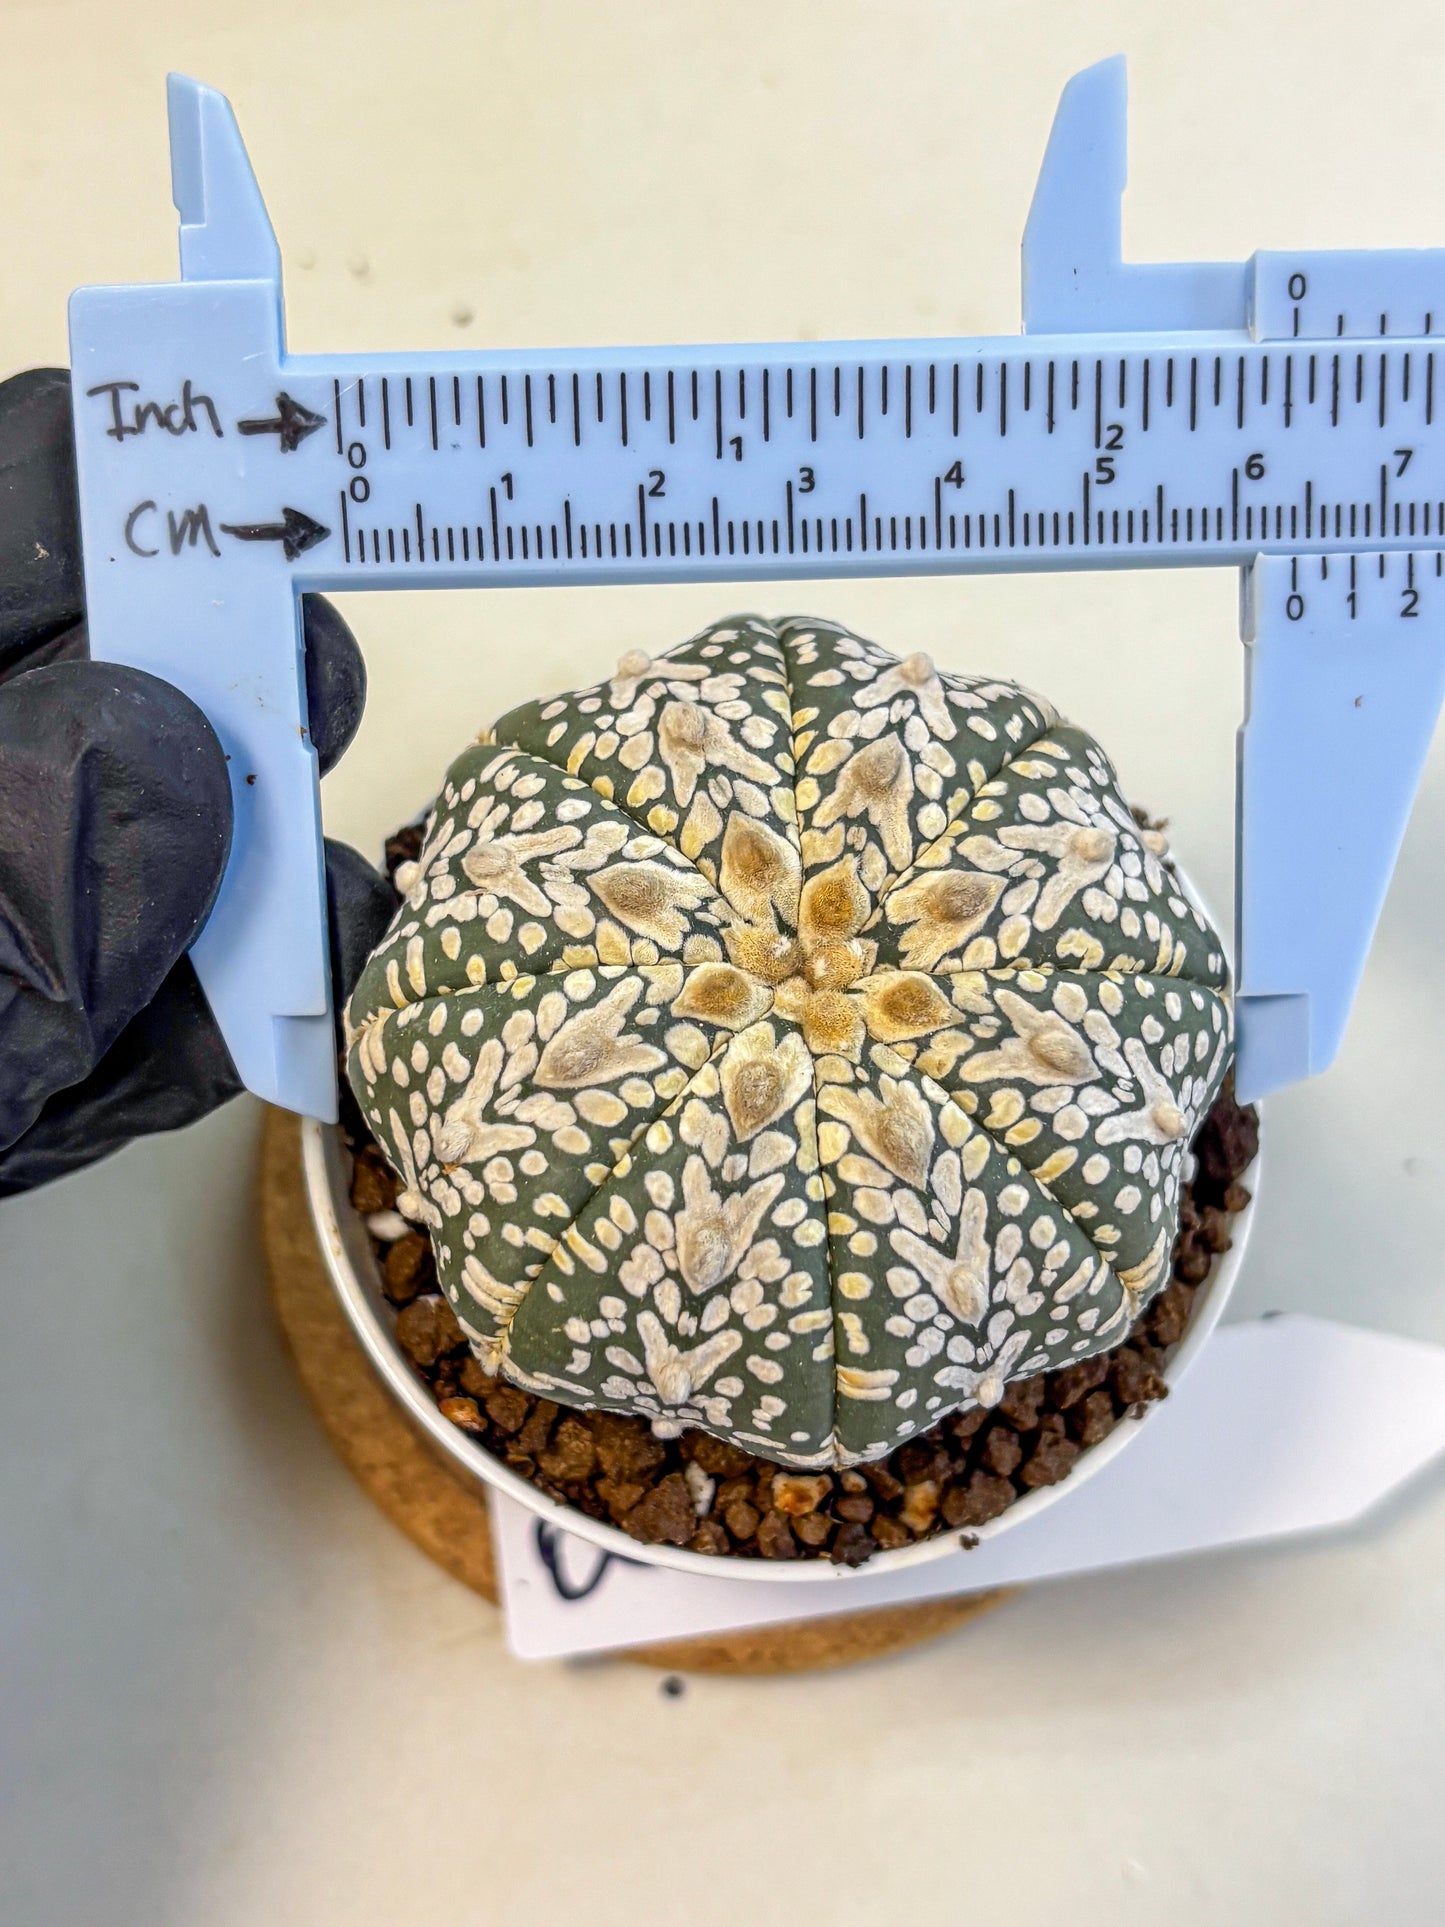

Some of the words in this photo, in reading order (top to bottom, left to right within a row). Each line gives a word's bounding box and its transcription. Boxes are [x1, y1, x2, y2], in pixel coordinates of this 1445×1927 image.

[1287, 272, 1307, 301] 0
[86, 379, 224, 442] Inch
[347, 441, 367, 470] 0
[728, 435, 743, 462] 1
[1104, 423, 1125, 452] 2
[349, 475, 371, 504] 0
[500, 472, 514, 501] 1
[647, 469, 666, 498] 2
[798, 466, 816, 494] 3
[943, 460, 966, 490] 4
[1095, 456, 1116, 485] 5
[1244, 452, 1266, 481] 6
[1393, 448, 1414, 478] 7
[1285, 593, 1305, 622] 0
[1346, 591, 1357, 620] 1
[1399, 588, 1420, 618] 2
